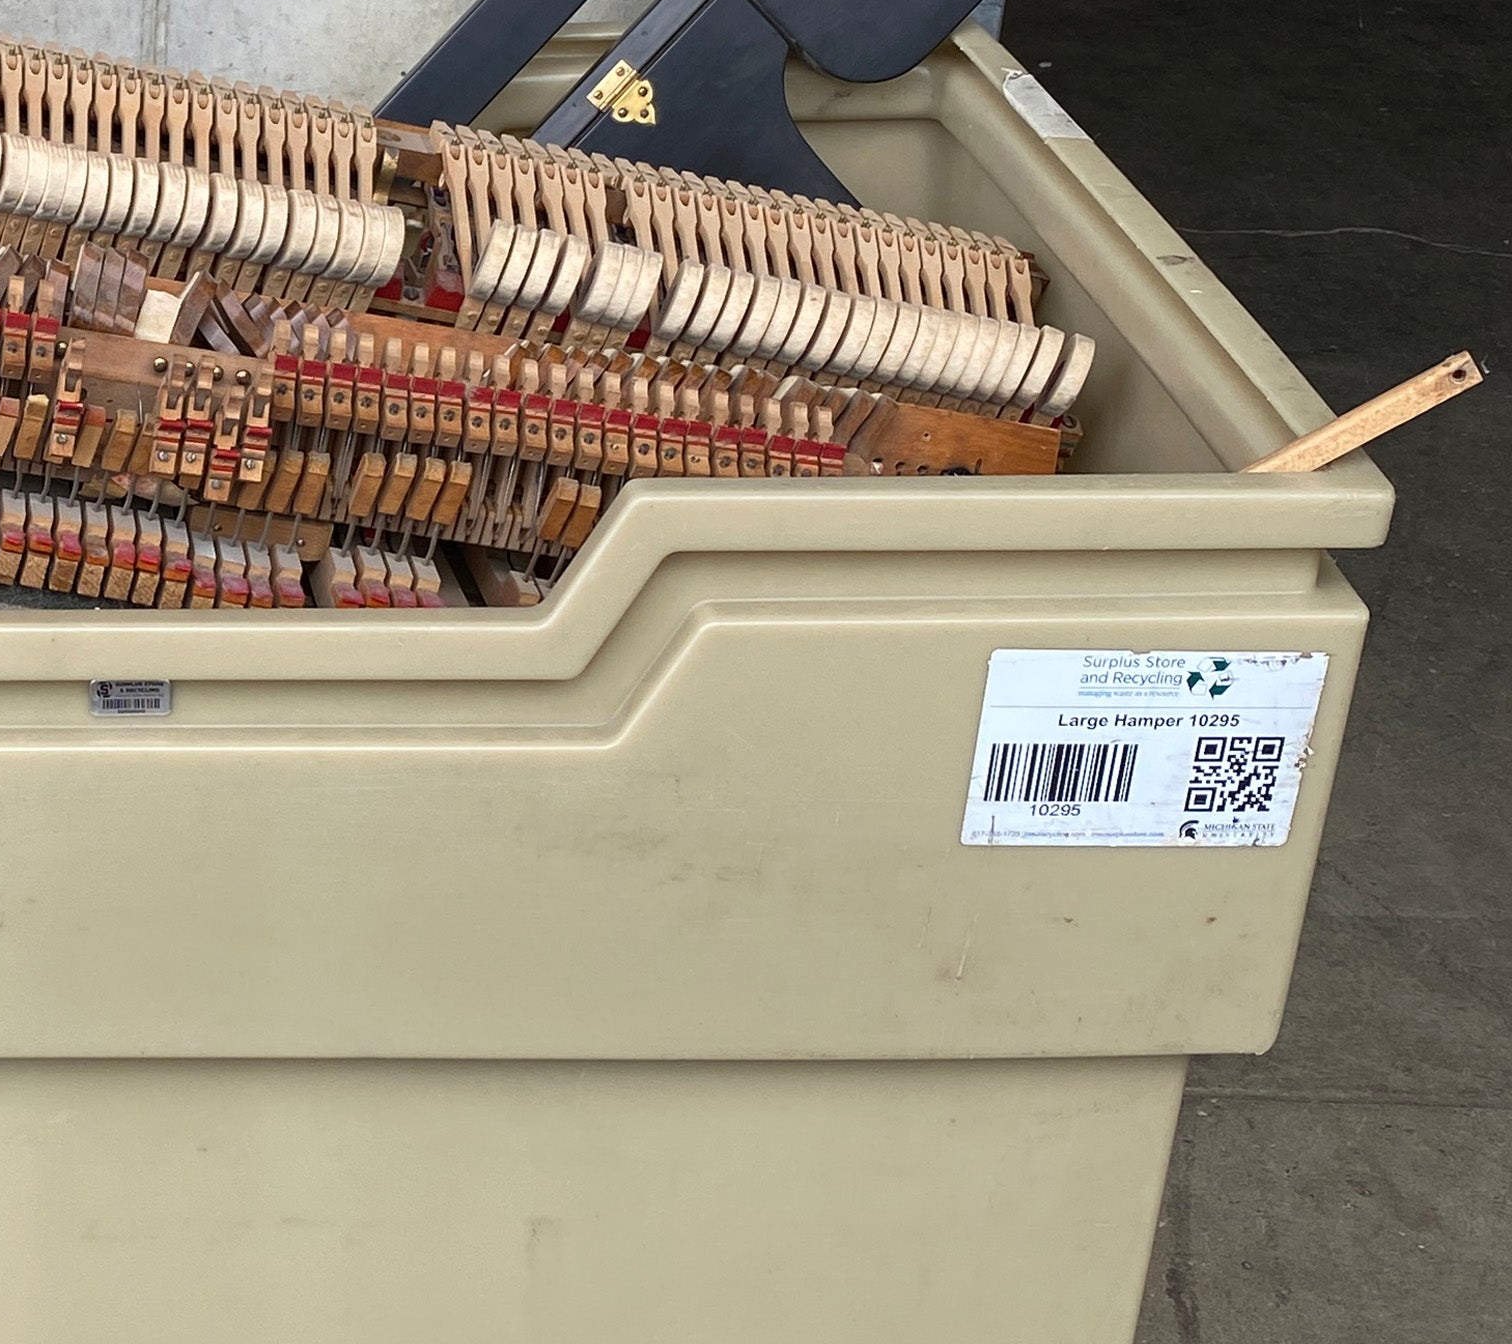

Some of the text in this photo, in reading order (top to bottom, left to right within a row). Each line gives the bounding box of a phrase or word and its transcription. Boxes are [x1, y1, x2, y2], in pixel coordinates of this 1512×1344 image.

[1082, 656, 1186, 670] Surplus Store
[1079, 671, 1183, 687] and Recycling
[1058, 714, 1240, 729] Large Hamper 10295
[1030, 804, 1081, 816] 10295
